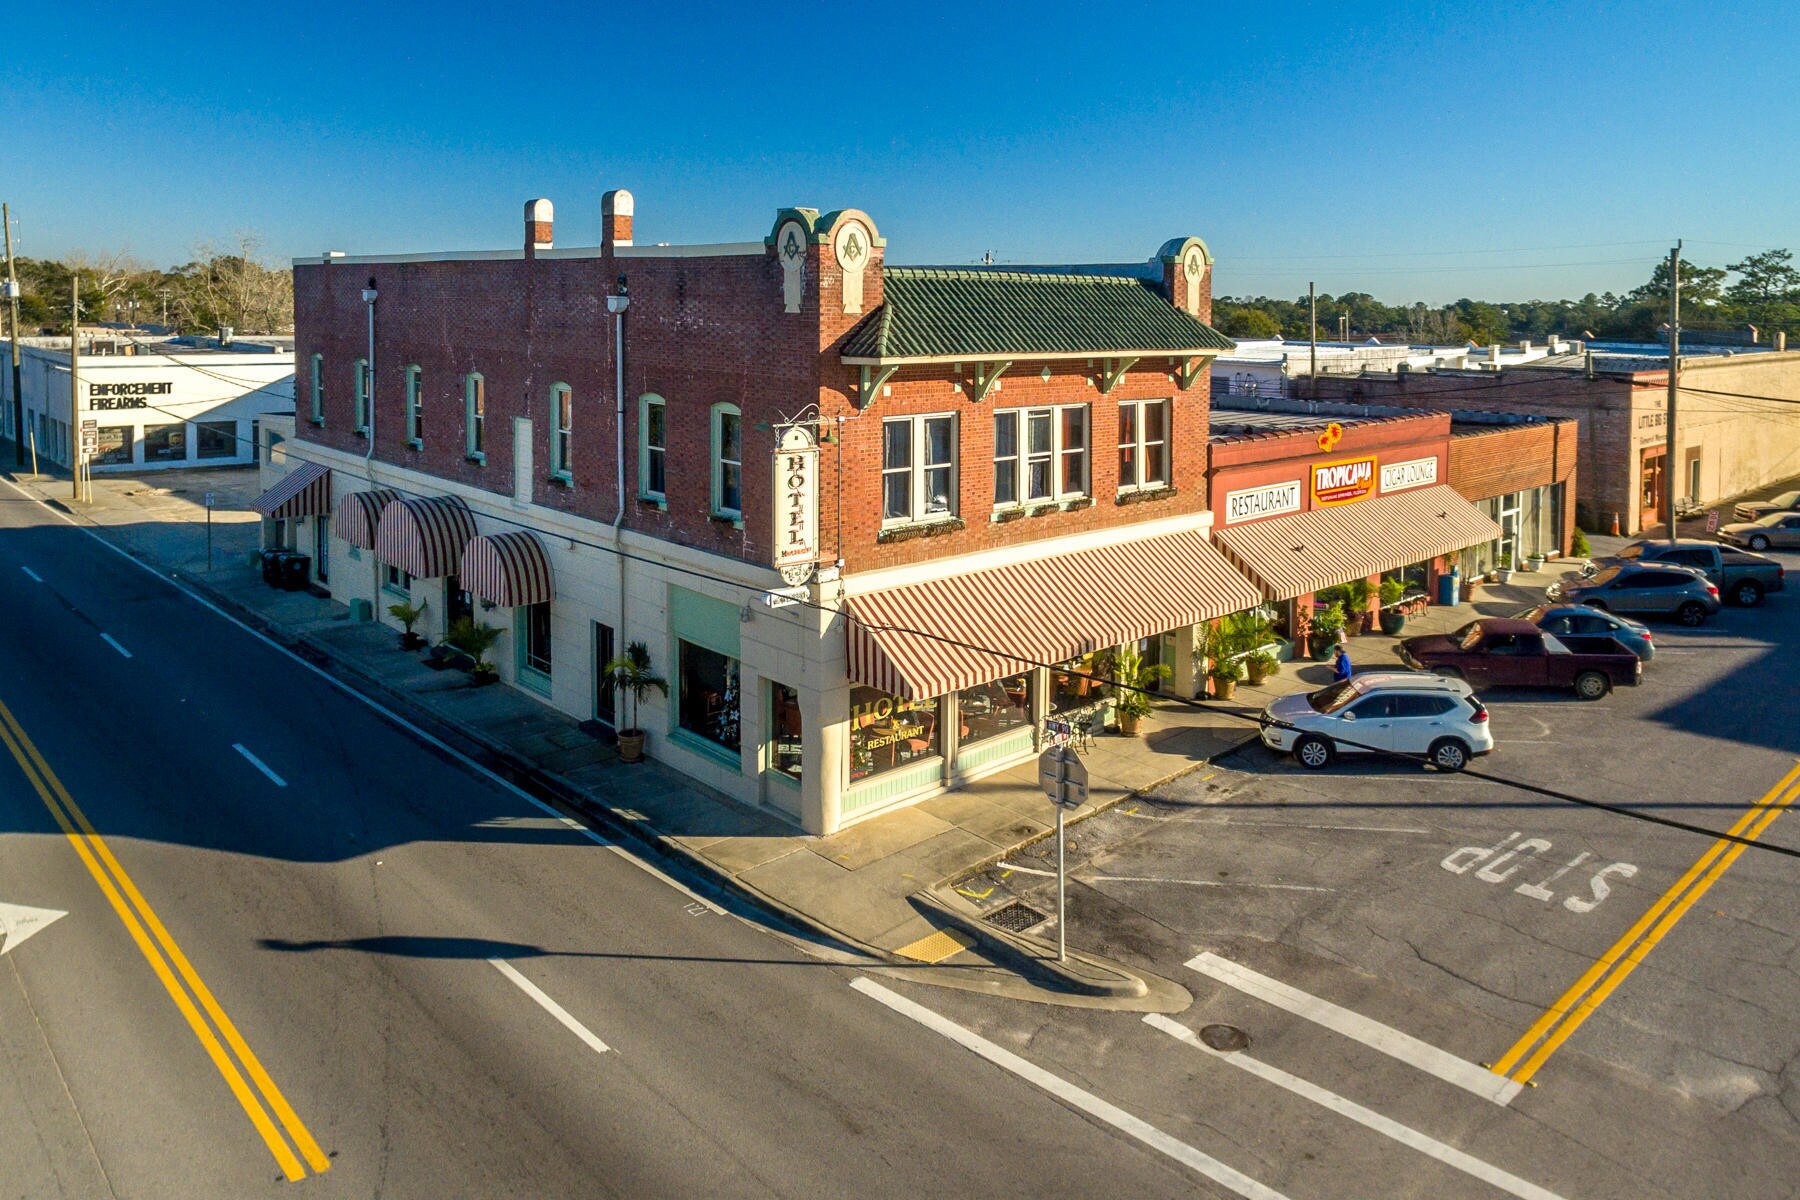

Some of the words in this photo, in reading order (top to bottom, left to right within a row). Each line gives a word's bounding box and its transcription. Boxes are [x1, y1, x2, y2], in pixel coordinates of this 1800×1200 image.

[90, 382, 173, 396] ENFORCEMENT
[90, 397, 147, 410] FIREARMS
[1638, 413, 1654, 429] LITTLE
[1316, 461, 1372, 491] TROPICANA
[1384, 467, 1406, 487] CIGAR
[1407, 462, 1433, 483] LOUNGE
[787, 454, 805, 545] HOTEL
[1231, 487, 1296, 518] RESTAURANT
[867, 725, 924, 750] RESTAURANT
